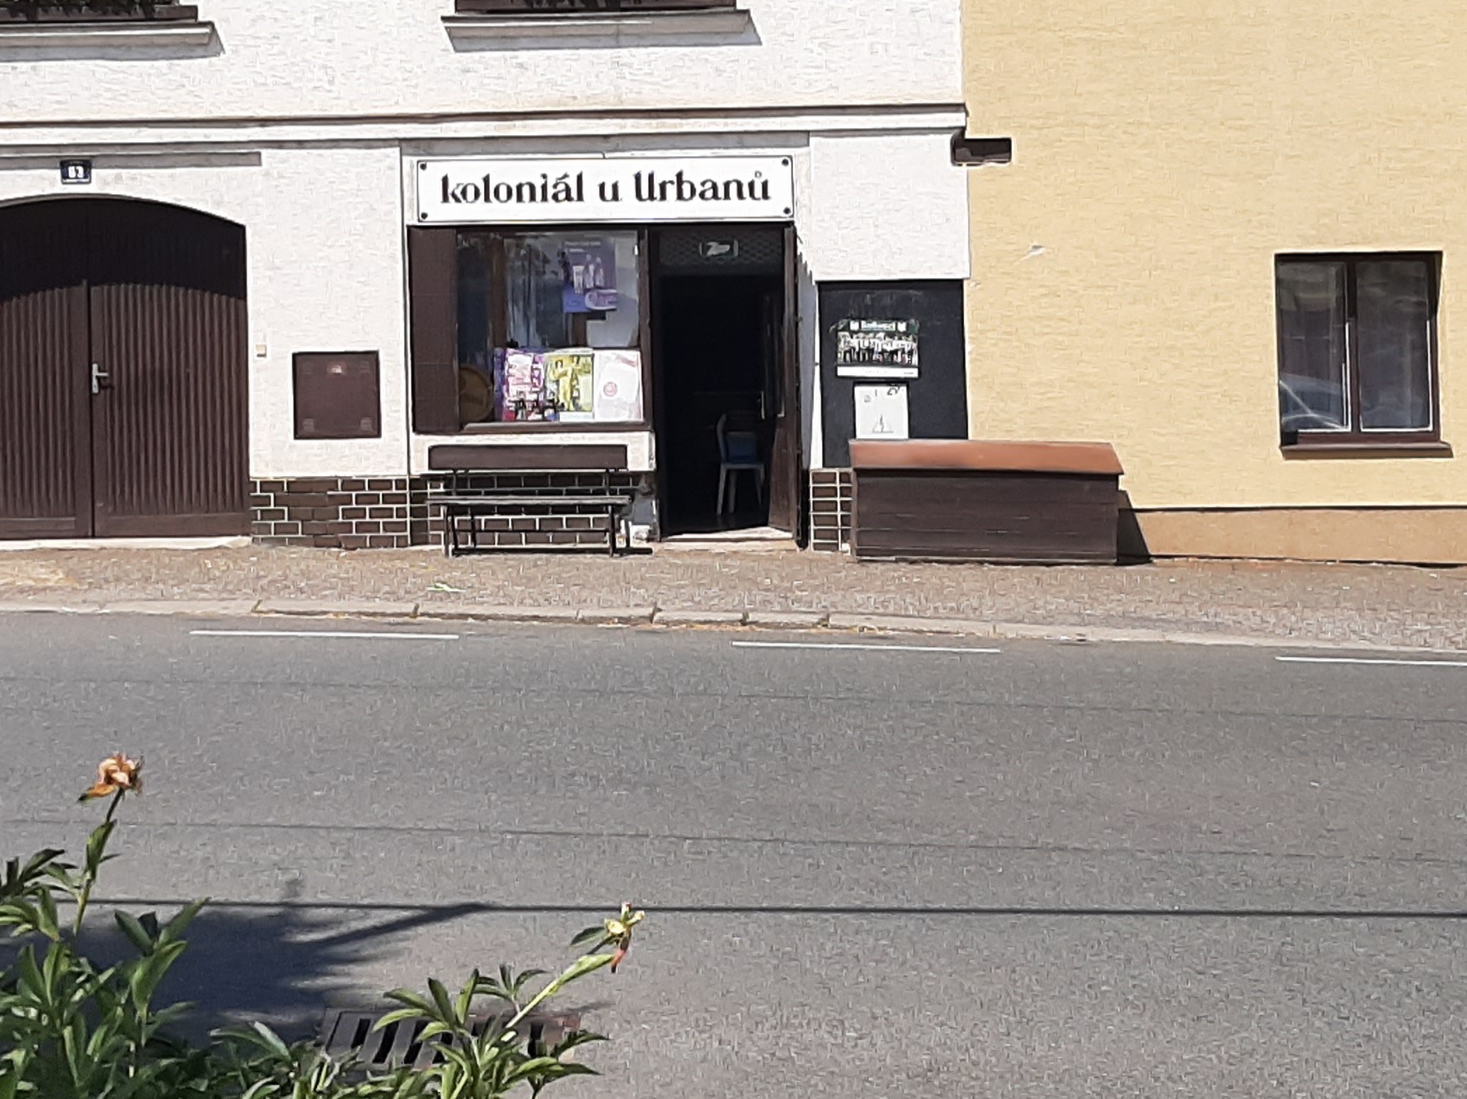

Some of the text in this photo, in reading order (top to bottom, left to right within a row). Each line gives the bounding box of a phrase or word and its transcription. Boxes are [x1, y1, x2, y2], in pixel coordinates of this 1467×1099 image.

[440, 170, 771, 204] koloniál u Urbanů
